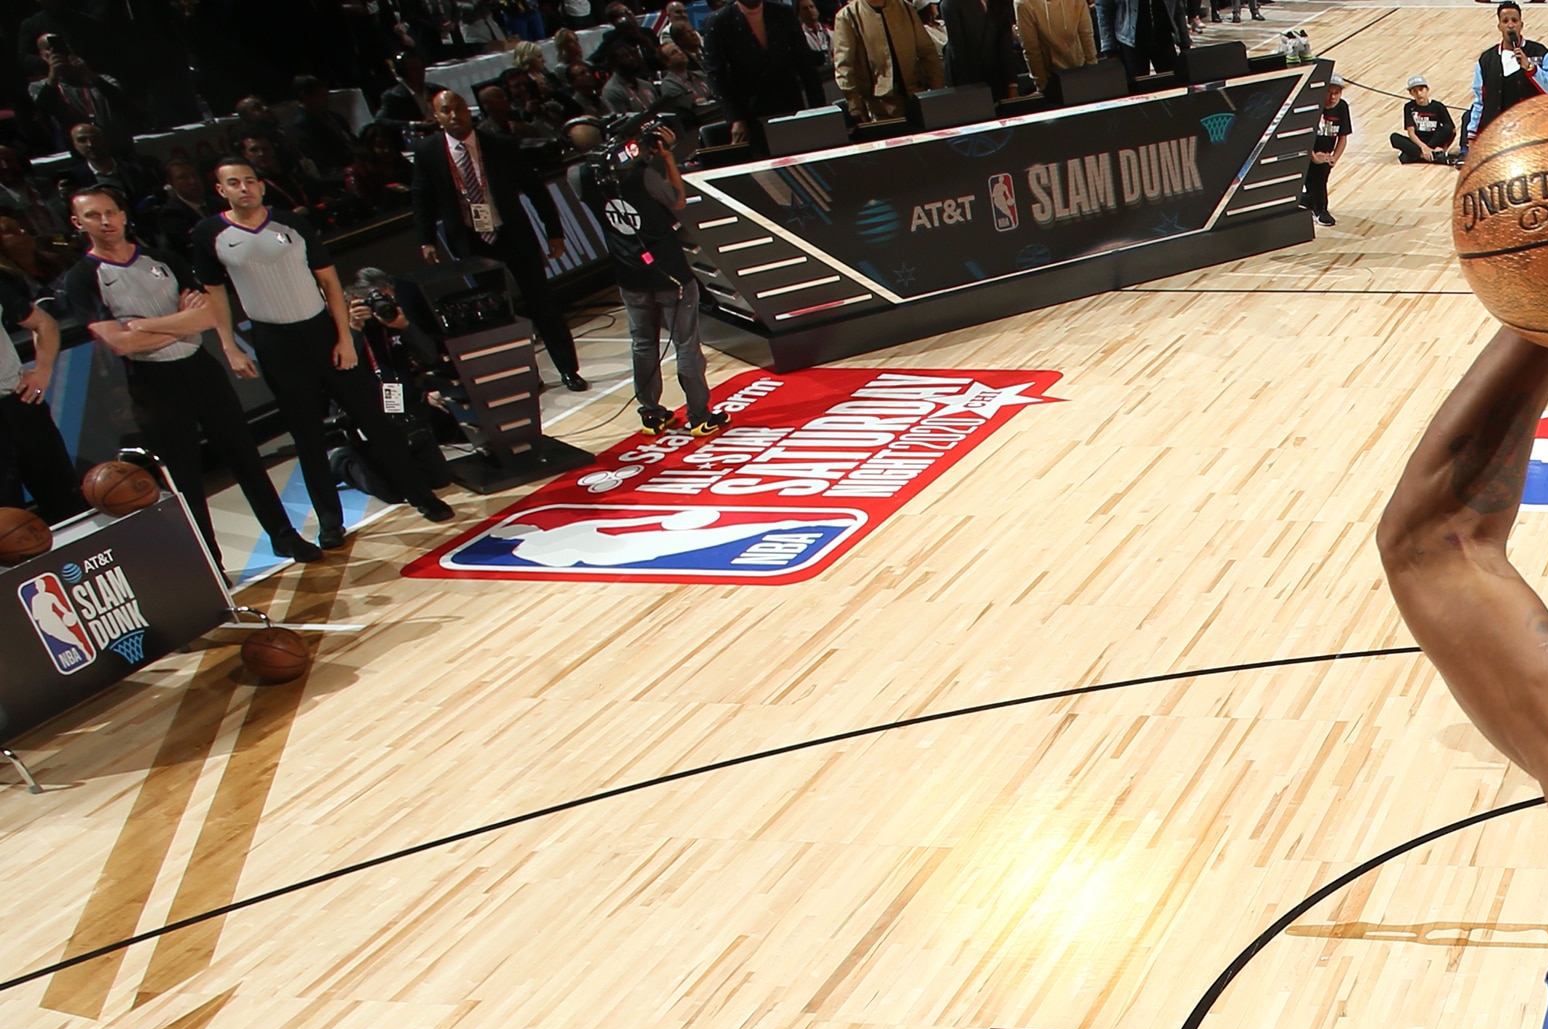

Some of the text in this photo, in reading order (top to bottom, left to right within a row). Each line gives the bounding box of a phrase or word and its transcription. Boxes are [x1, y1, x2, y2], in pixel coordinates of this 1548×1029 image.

[910, 136, 1203, 231] AT&T SLAM DUNK
[605, 210, 641, 228] TNT
[618, 380, 784, 464] Stat arm
[963, 390, 1003, 410] CHI
[709, 373, 974, 497] SATURDAY
[635, 427, 796, 496] ALL STAR
[83, 548, 115, 574] AT&T
[730, 532, 824, 565] NBA
[72, 566, 136, 621] SLAM
[88, 600, 150, 651] DUNK
[58, 648, 82, 669] NBA
